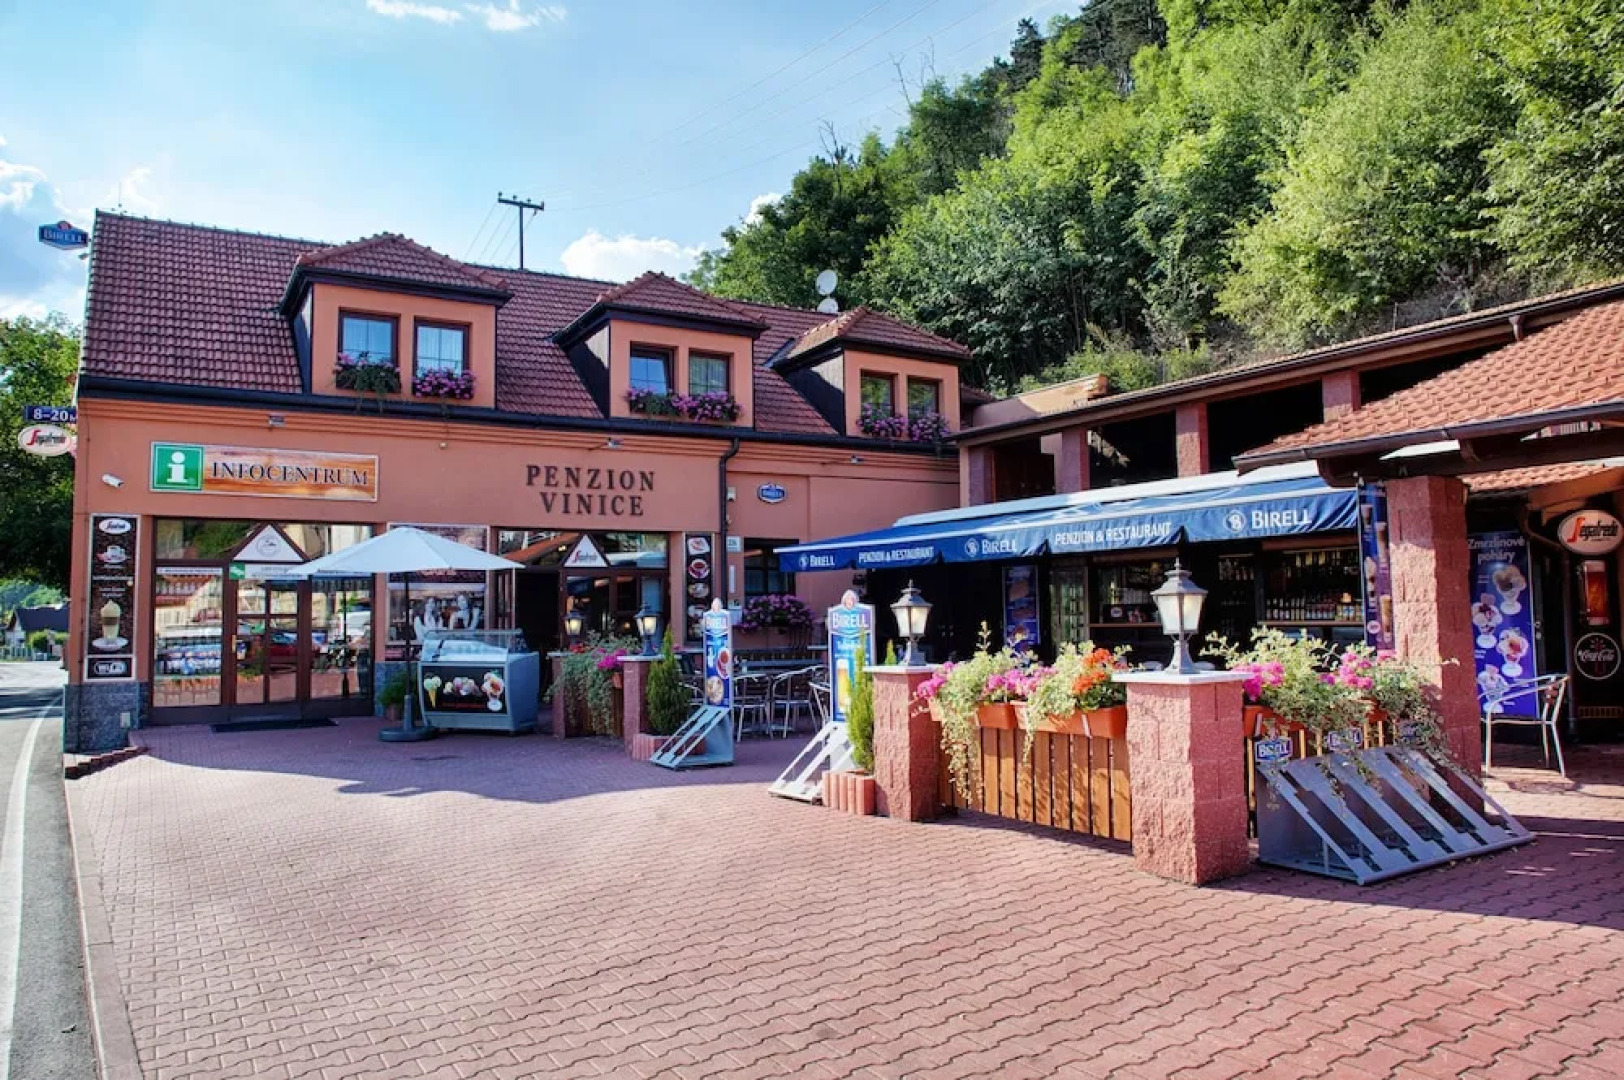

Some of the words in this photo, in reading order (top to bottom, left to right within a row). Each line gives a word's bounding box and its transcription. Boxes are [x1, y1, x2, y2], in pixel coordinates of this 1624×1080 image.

[211, 461, 368, 486] INFOCENTRUM
[526, 464, 655, 491] PENZION
[539, 492, 643, 516] VINICE
[1251, 509, 1312, 529] BIRELL
[1054, 530, 1094, 546] PENZION
[1096, 530, 1102, 544] &
[1105, 522, 1171, 542] RESTAURANT
[981, 538, 1017, 555] BIRELL
[809, 555, 835, 567] BIRELL
[832, 611, 870, 629] BIRELL
